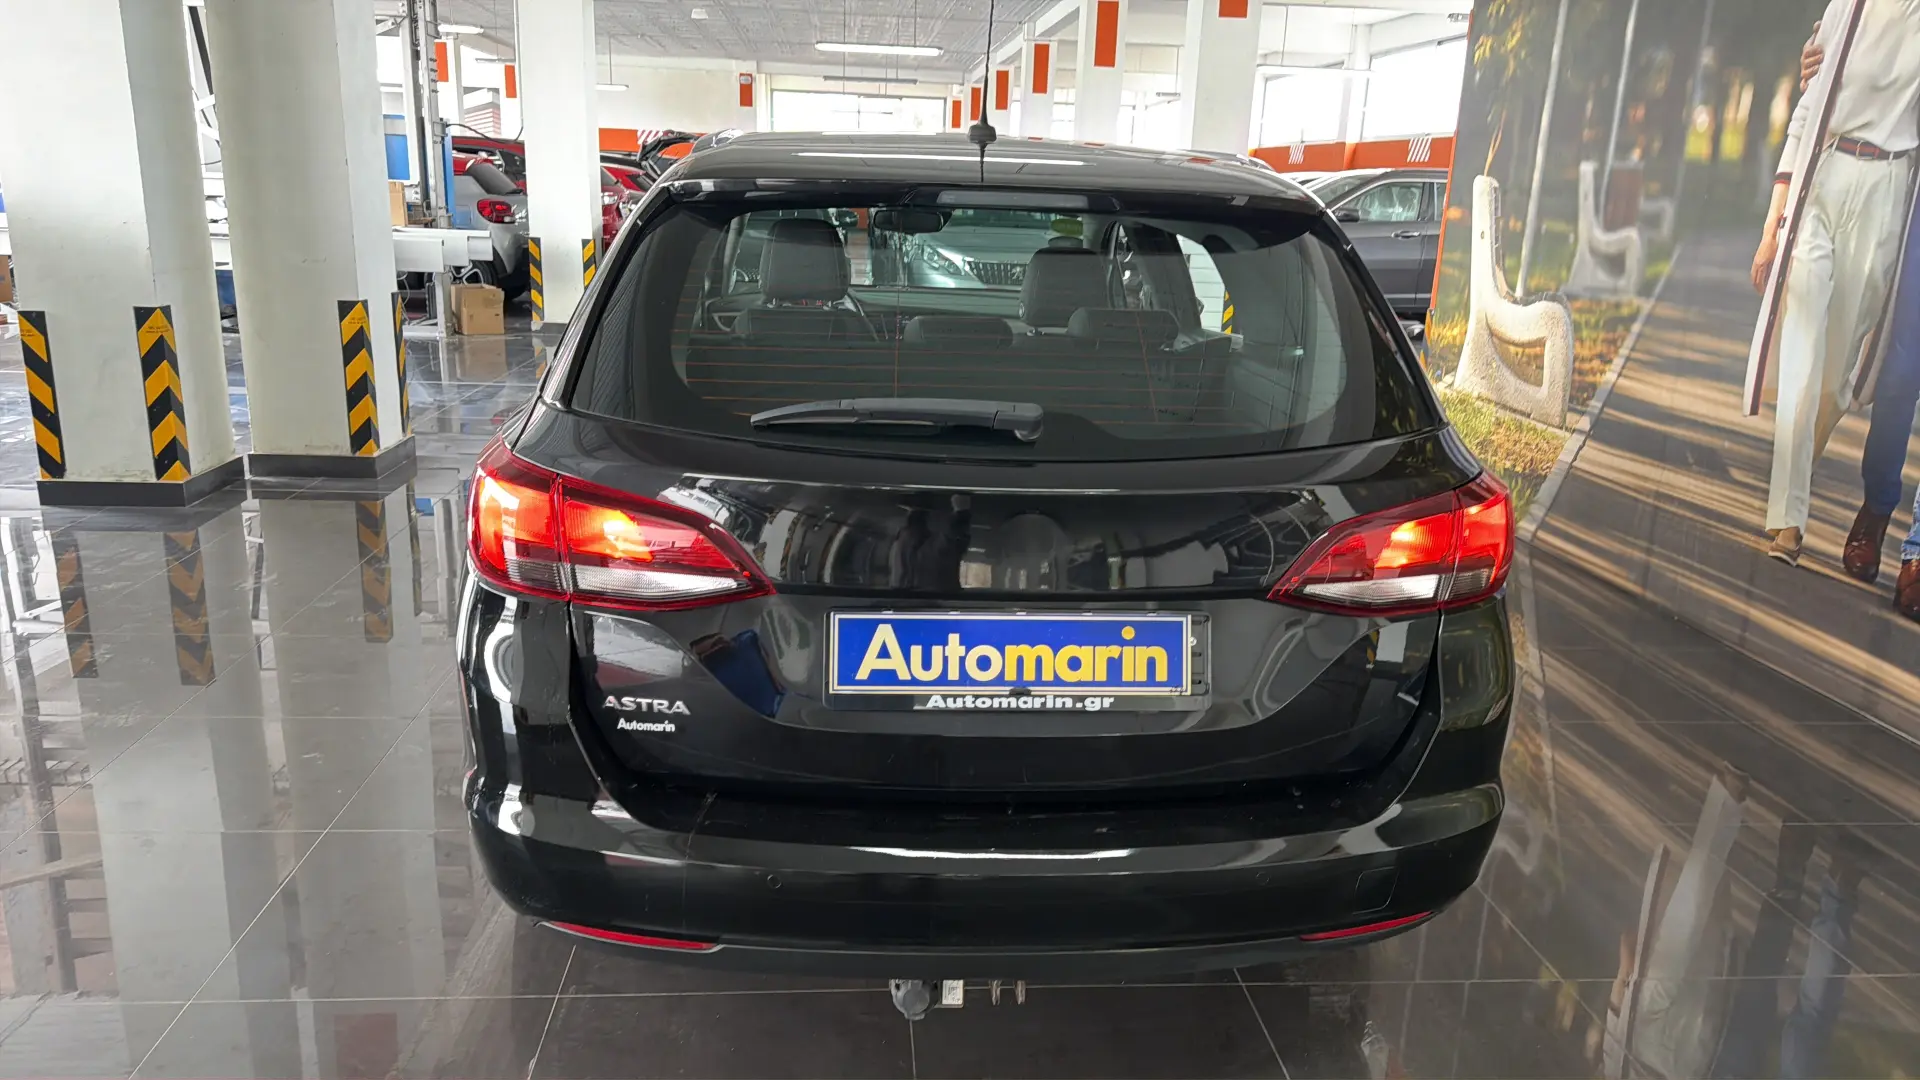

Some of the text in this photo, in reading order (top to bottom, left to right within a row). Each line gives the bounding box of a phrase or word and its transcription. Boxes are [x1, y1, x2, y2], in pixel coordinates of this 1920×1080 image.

[855, 623, 1168, 683] Automarin
[602, 695, 691, 715] ASTRA
[926, 694, 1115, 712] Automarin.gr
[617, 717, 676, 732] Automarin
